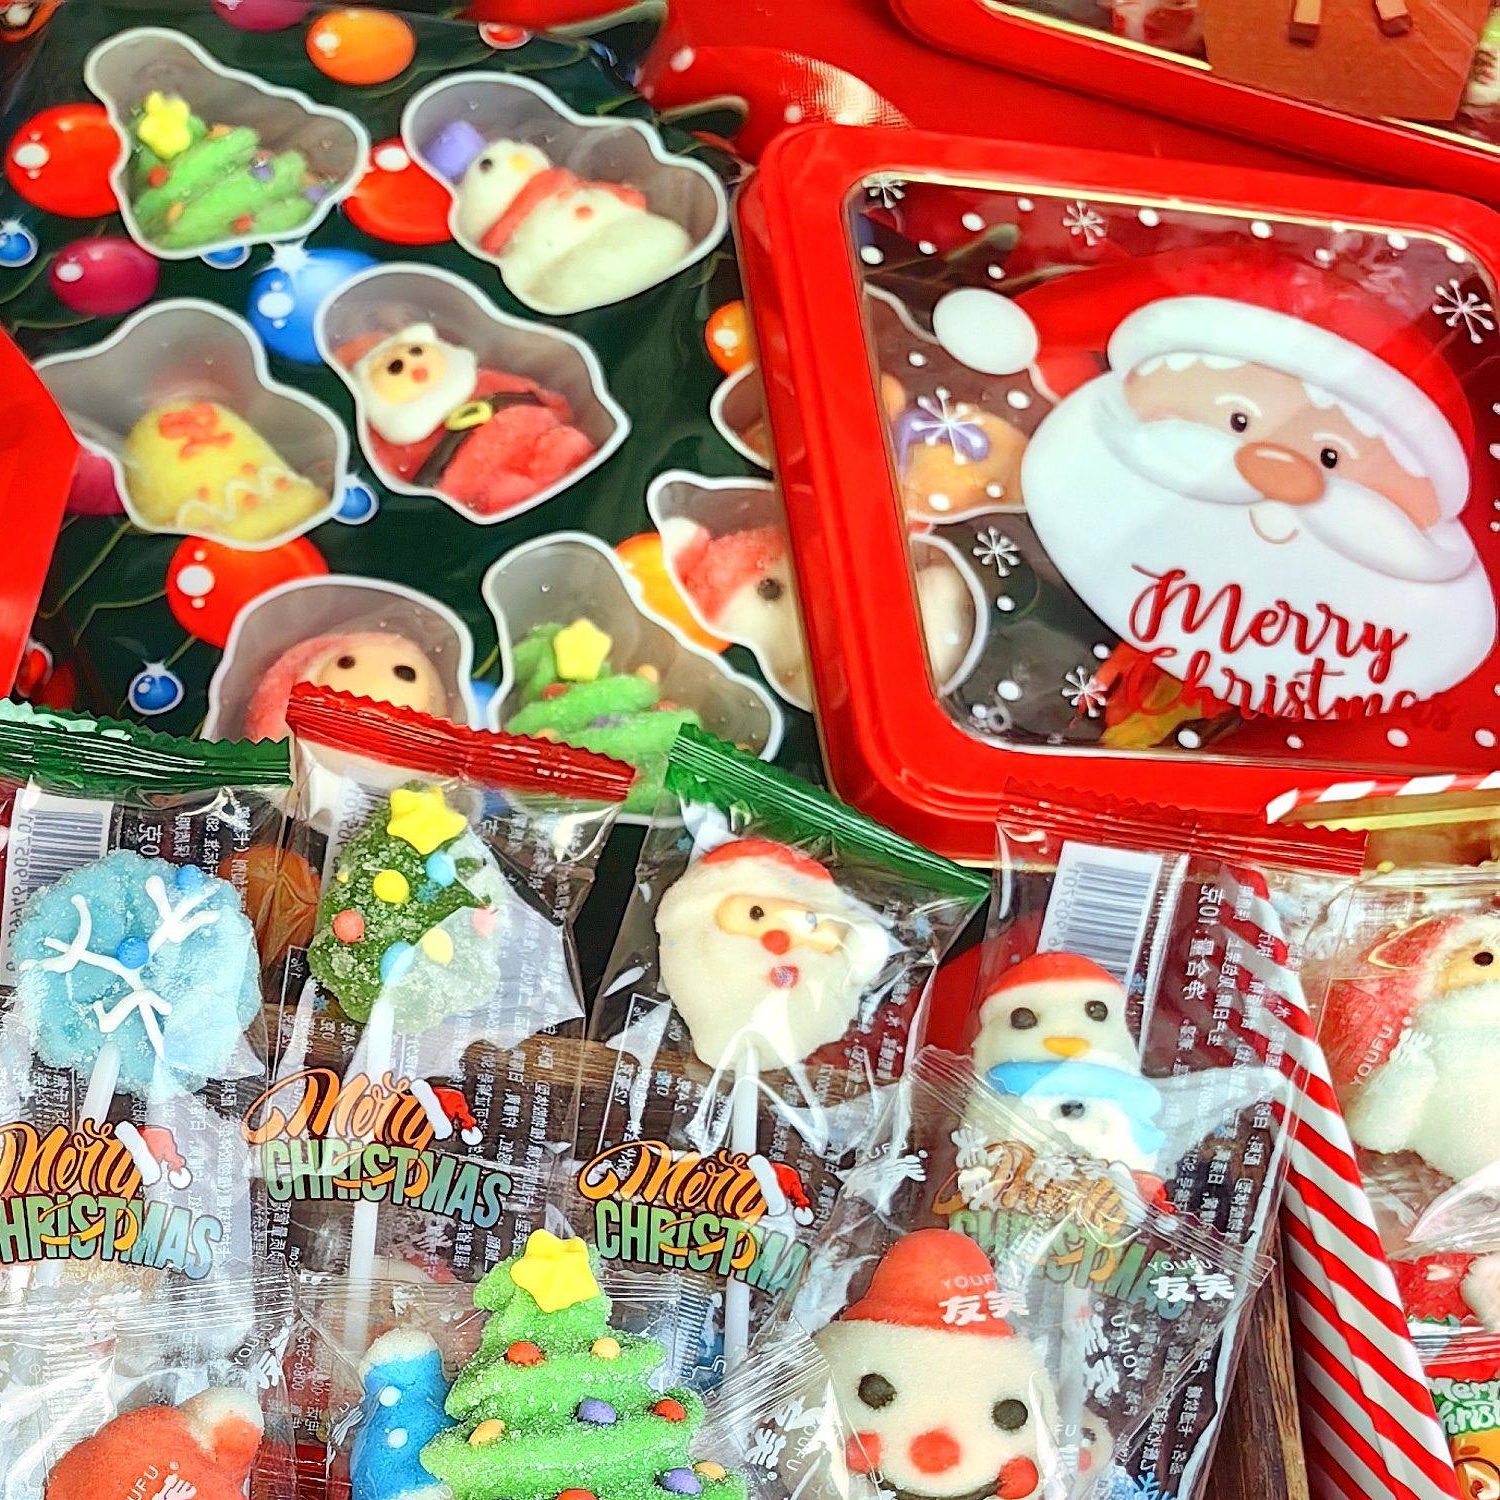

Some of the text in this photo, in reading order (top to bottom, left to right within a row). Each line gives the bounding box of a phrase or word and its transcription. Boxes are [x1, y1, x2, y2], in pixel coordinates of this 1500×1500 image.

[1128, 563, 1409, 680] Merry
[240, 1067, 437, 1151] Merry
[578, 1140, 767, 1219] Merry
[941, 1272, 1000, 1290] YOUF
[1148, 1255, 1214, 1274] YOUFU
[939, 1289, 1029, 1326] 友芙
[1150, 1275, 1235, 1303] 友芙
